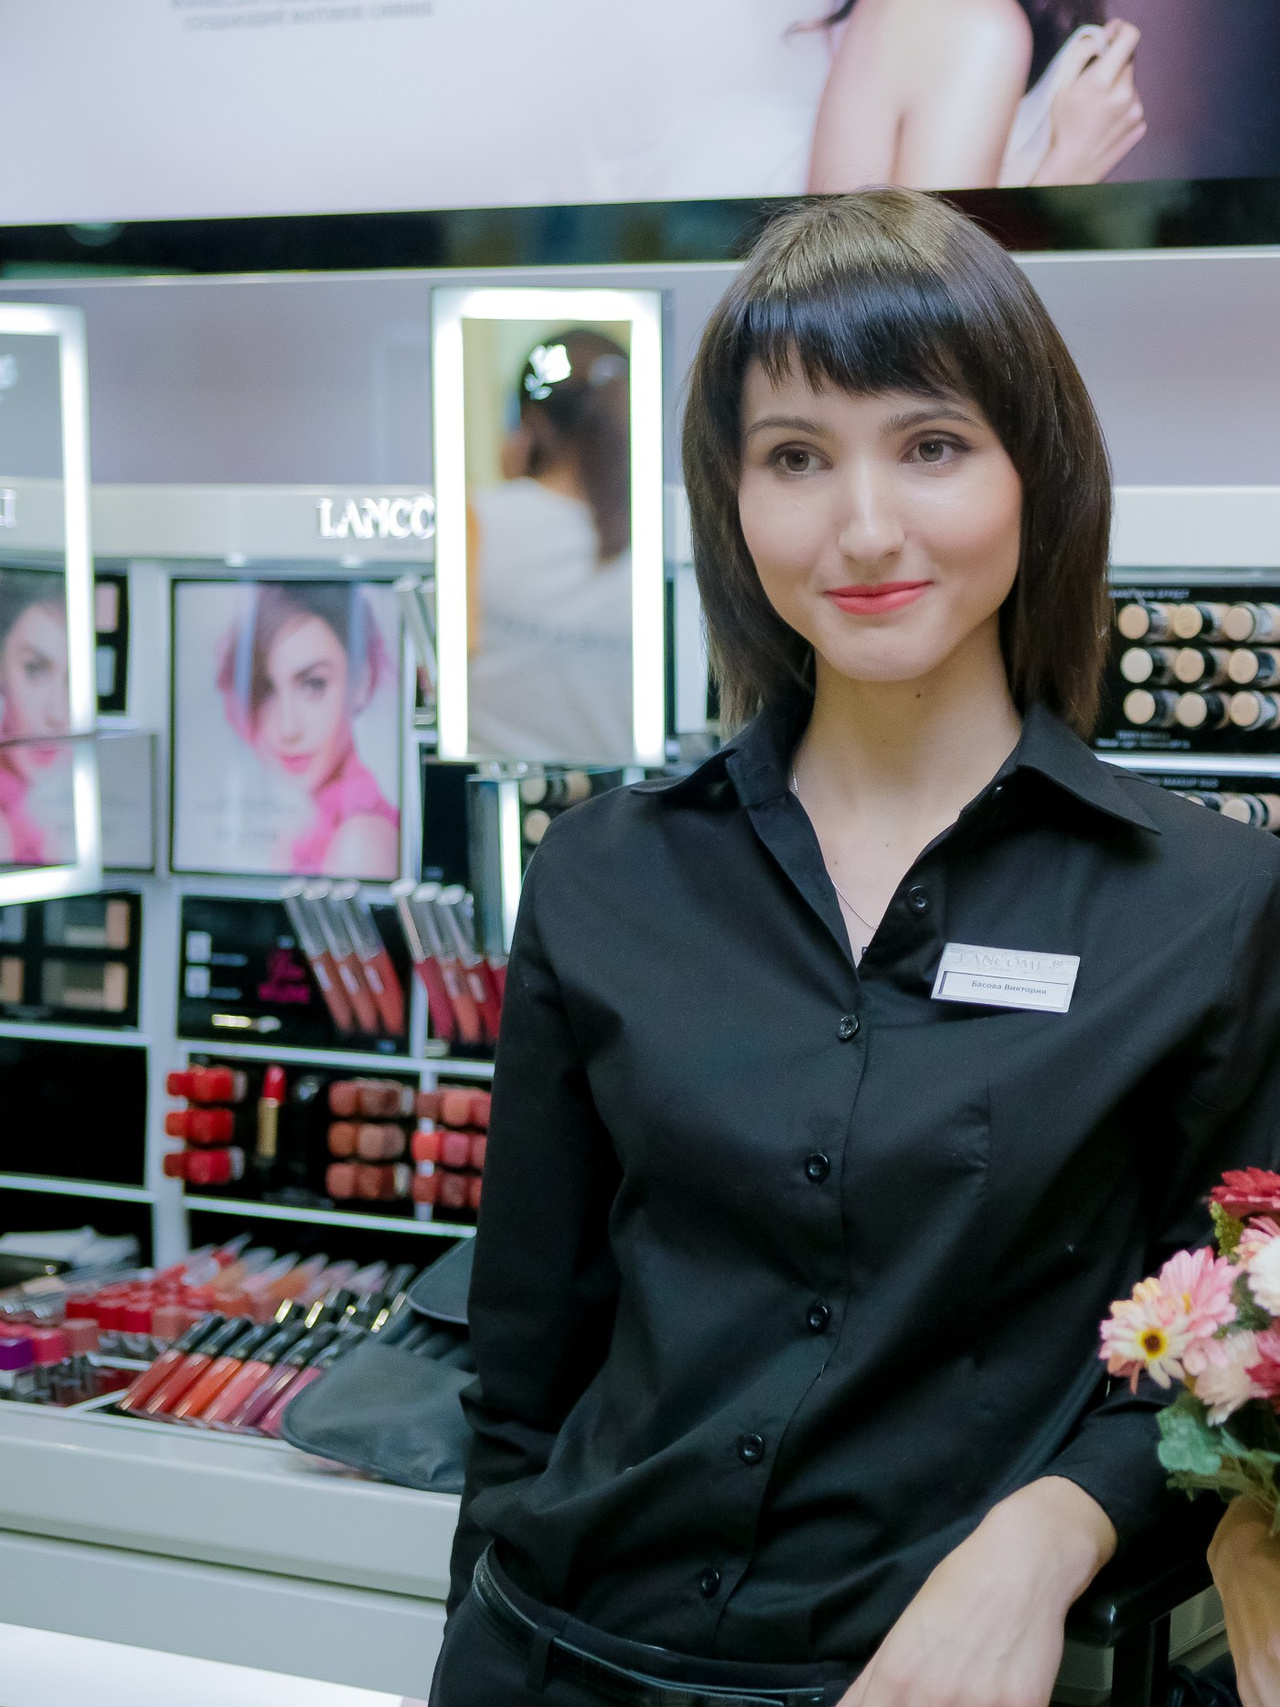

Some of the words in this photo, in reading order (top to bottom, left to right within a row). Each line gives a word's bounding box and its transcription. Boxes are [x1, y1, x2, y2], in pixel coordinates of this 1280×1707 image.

[316, 492, 436, 540] LANCÔ
[971, 980, 1002, 990] Басова
[1004, 984, 1047, 995] Виктория
